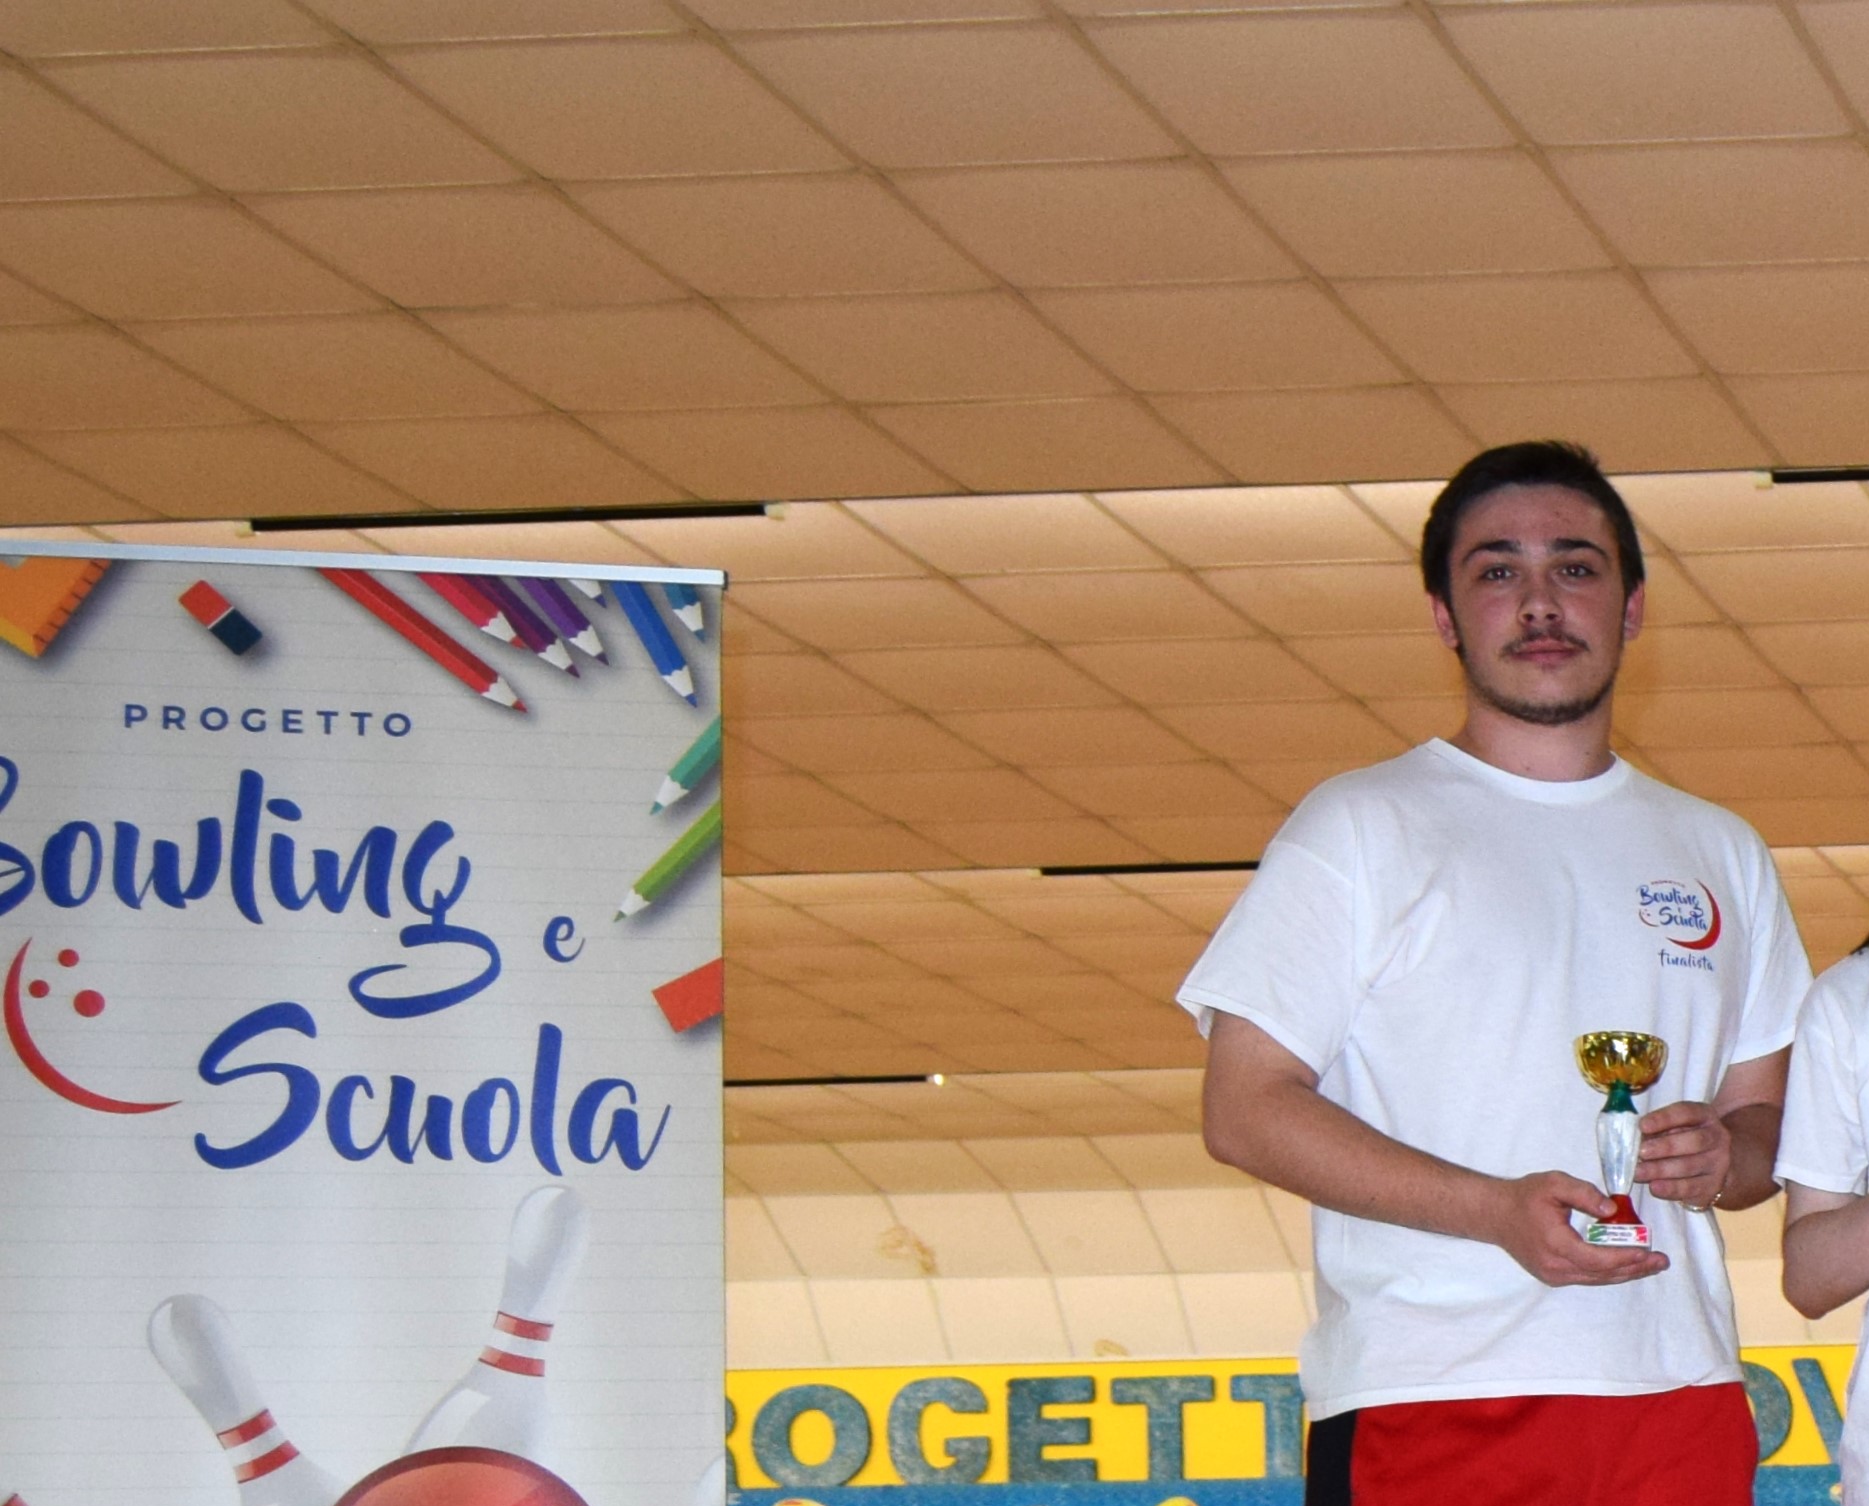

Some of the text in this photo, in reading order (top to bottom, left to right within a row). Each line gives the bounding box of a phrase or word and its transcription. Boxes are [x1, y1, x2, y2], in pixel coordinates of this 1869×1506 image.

[123, 703, 414, 738] PROGETTO
[0, 755, 502, 1019] owling
[542, 915, 586, 963] e
[193, 1002, 672, 1177] Scuola
[725, 1373, 1305, 1491] OGETT
